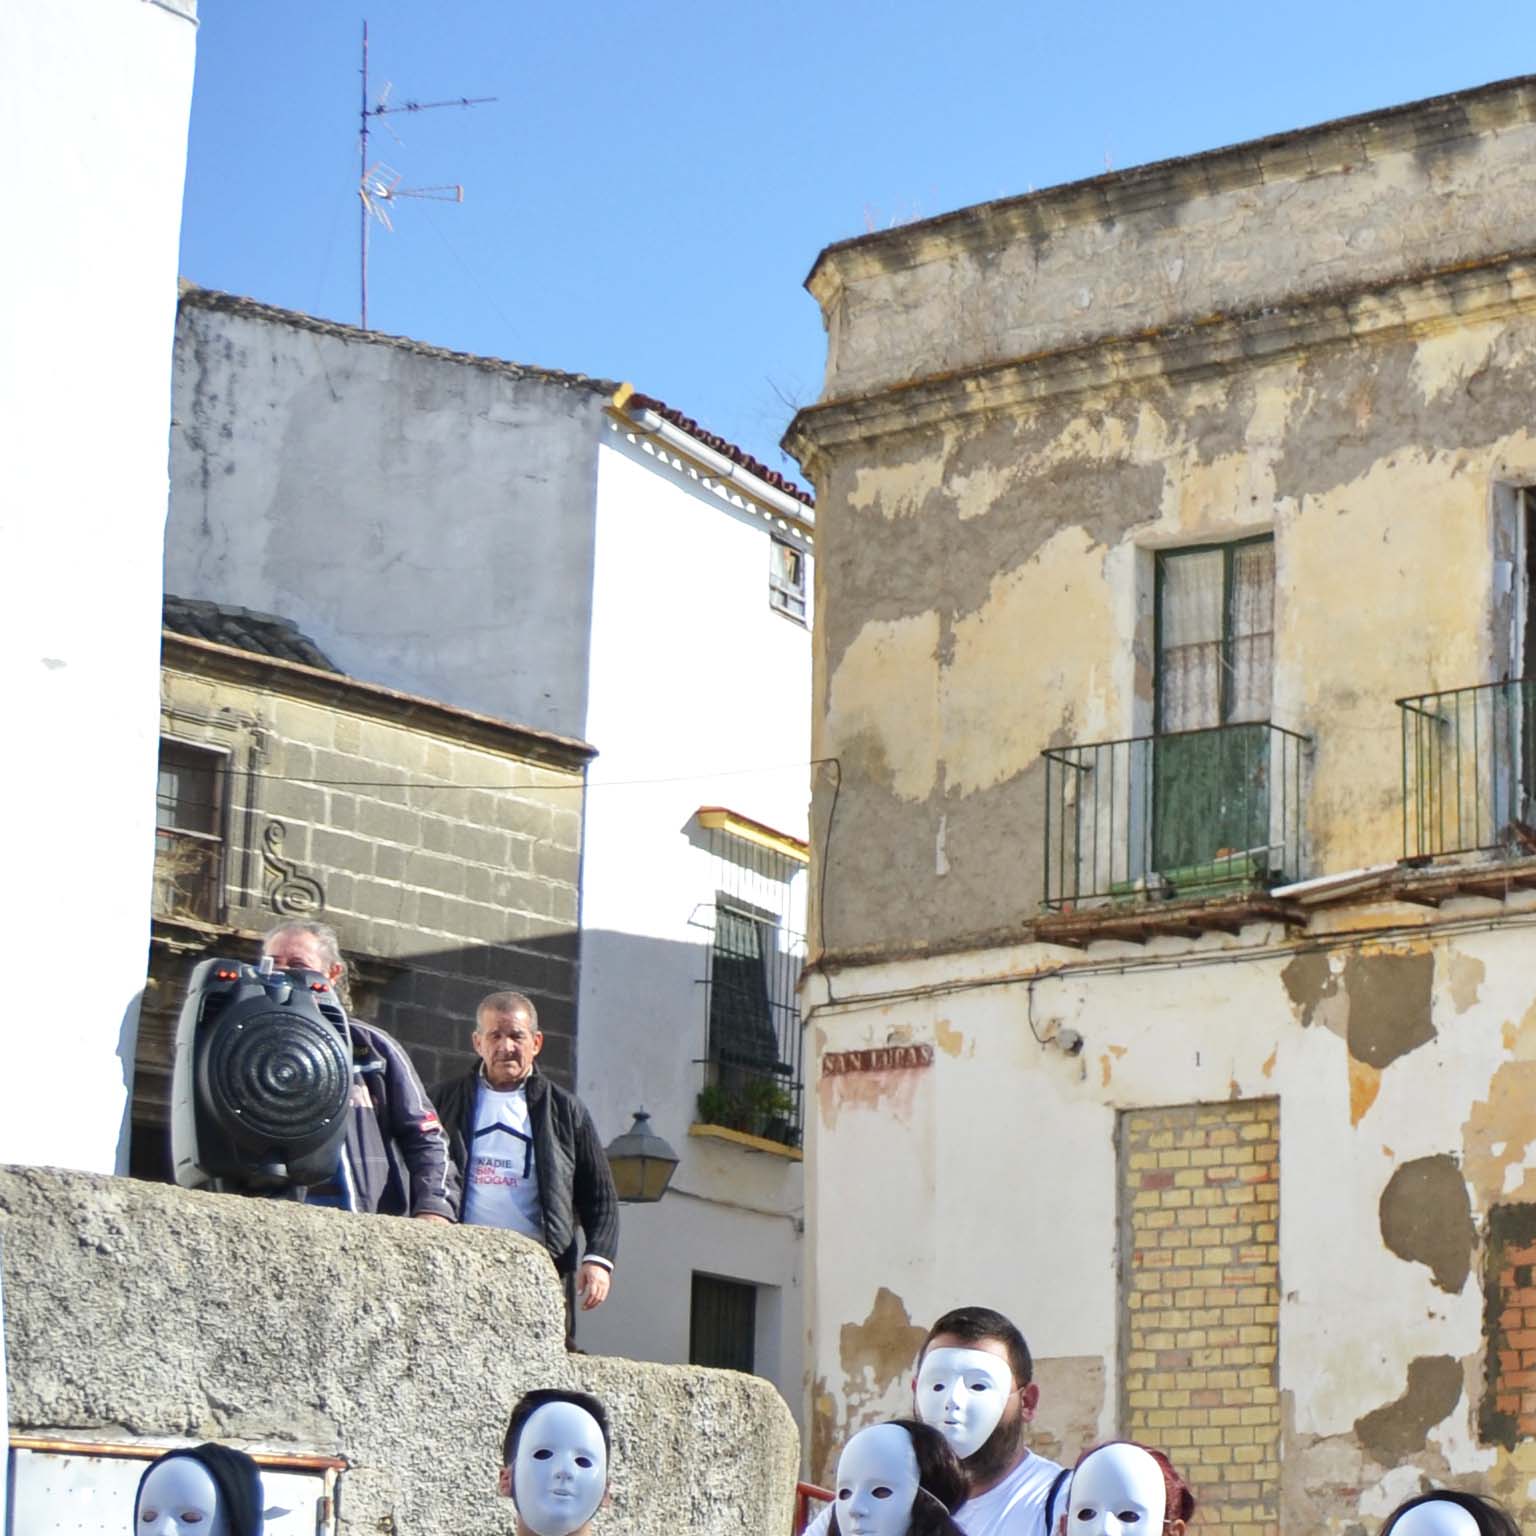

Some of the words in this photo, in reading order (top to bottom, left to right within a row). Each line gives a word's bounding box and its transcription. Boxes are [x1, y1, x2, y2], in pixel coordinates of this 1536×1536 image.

[476, 1156, 513, 1168] NADIE
[476, 1166, 496, 1176] SIN
[474, 1175, 518, 1188] HOGAR
